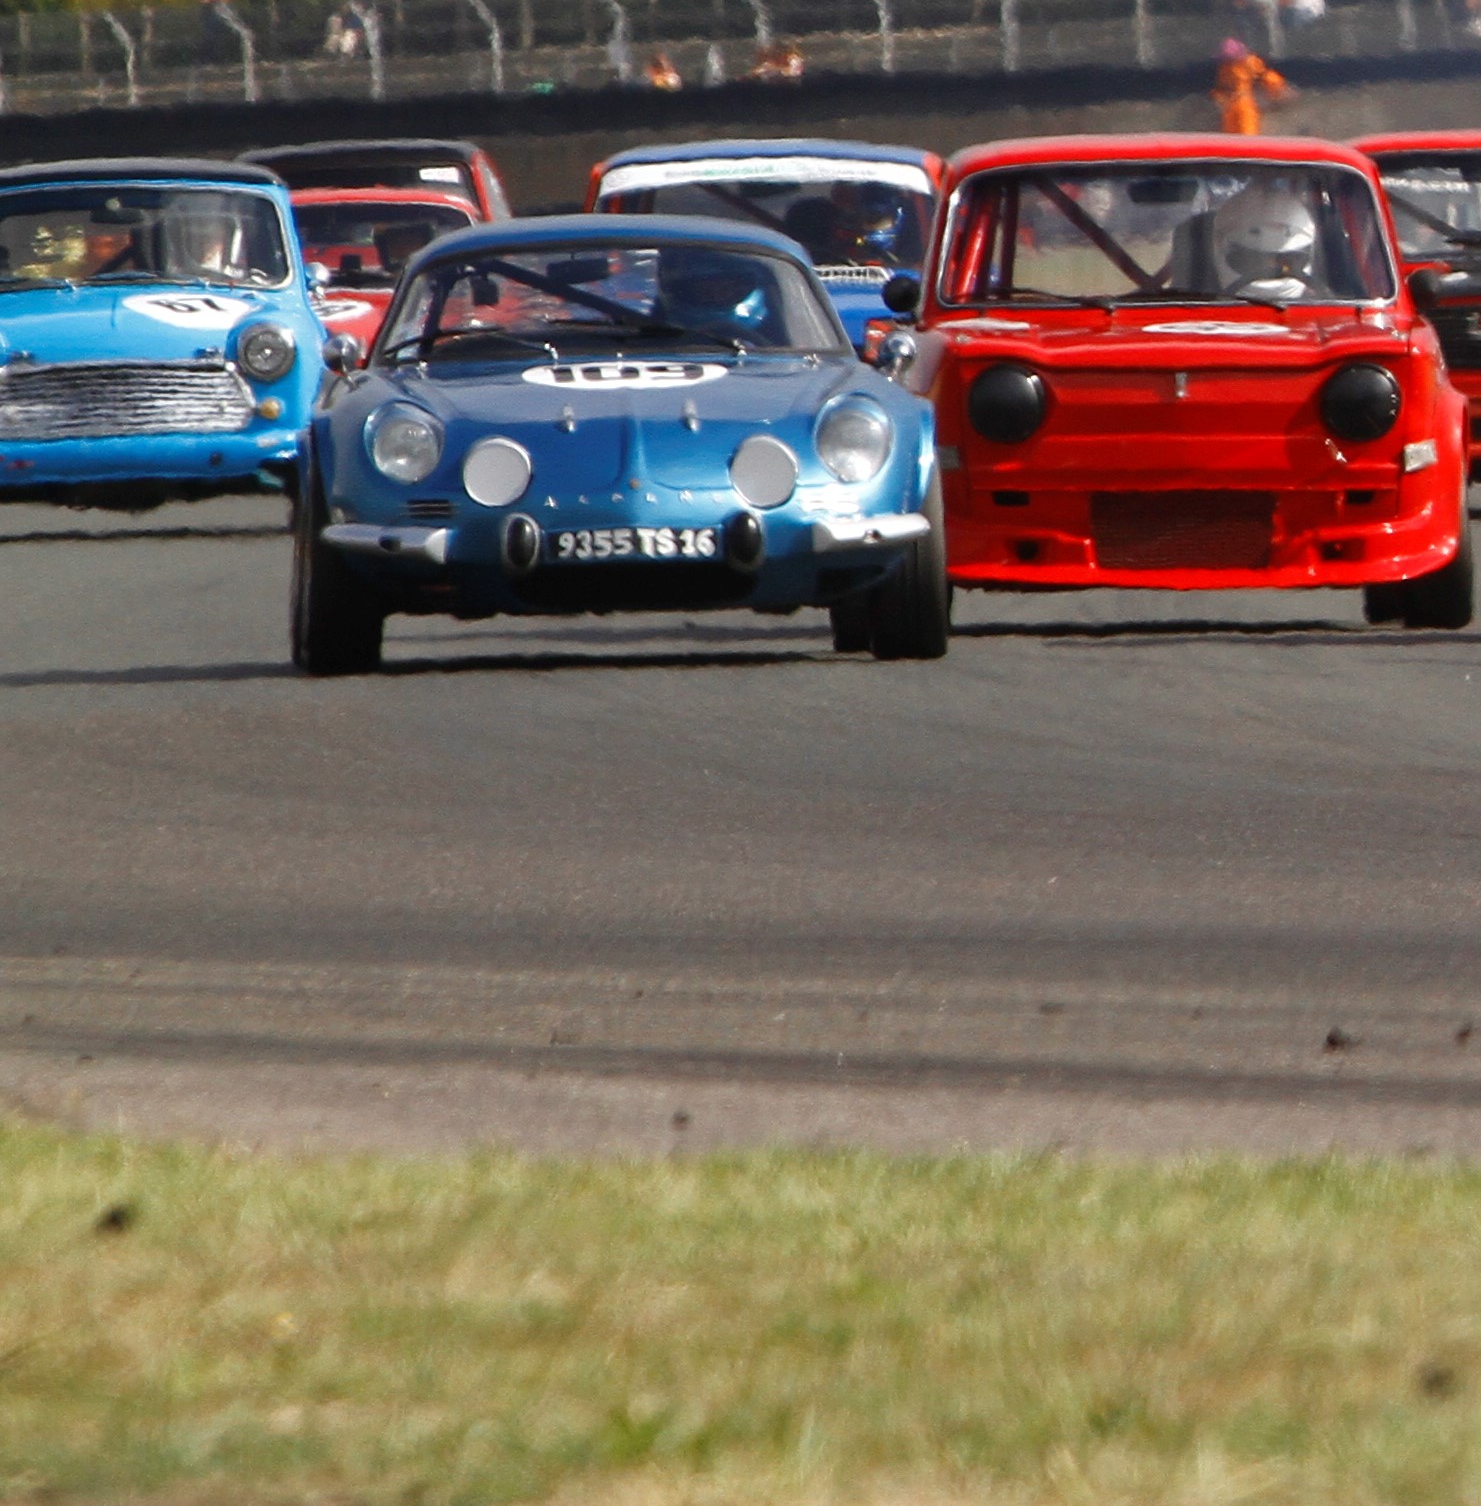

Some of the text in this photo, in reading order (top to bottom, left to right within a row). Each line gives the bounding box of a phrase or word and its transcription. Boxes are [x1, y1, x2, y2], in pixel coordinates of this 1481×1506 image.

[147, 297, 228, 313] 67
[547, 365, 705, 384] 109
[557, 526, 717, 561] 9355 TS 16
